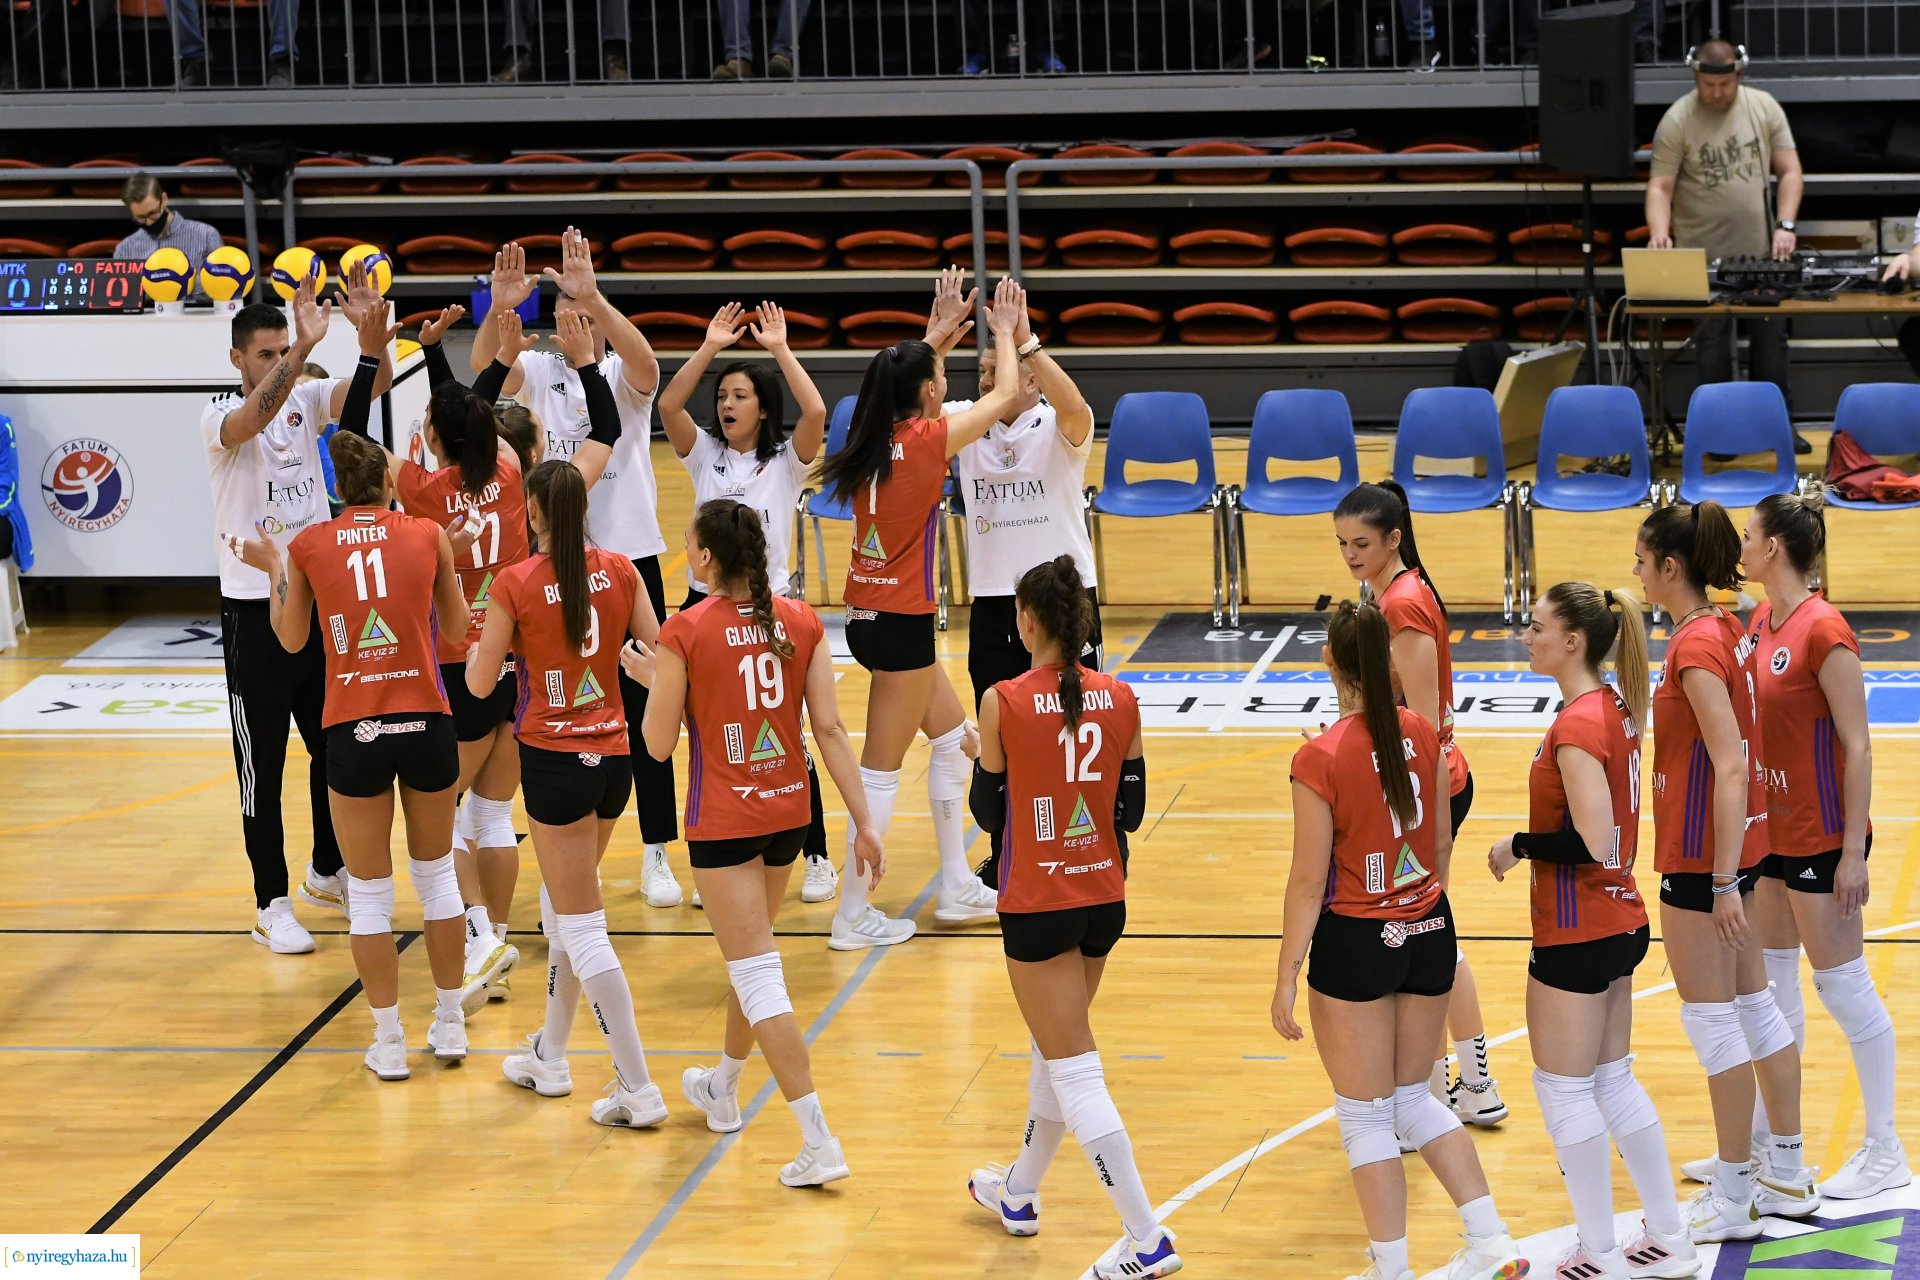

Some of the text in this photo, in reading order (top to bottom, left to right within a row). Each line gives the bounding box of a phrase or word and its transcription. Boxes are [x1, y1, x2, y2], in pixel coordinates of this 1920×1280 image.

[96, 263, 143, 274] FATUM
[62, 441, 108, 455] FATUM
[972, 478, 1045, 499] FATUM
[974, 494, 1047, 506] PROPERTY
[992, 515, 1050, 529] NYÍREGYHÁZA
[336, 525, 388, 546] PINTÉR
[346, 548, 388, 601] 11
[333, 616, 347, 652] STRABAG
[358, 646, 398, 659] KE-VIZ 21
[360, 669, 419, 683] BESTRONG
[738, 652, 784, 711] 19
[552, 672, 561, 705] STRABAG
[381, 720, 426, 735] REVESZ
[730, 725, 740, 762] STRABAG
[1058, 722, 1102, 783] 12
[750, 762, 776, 772] KE-VIZ
[758, 781, 804, 799] BESTRONG
[1041, 799, 1050, 838] STRABAG
[1063, 835, 1092, 848] KE-VIZ
[1065, 858, 1113, 875] BESTRONG
[1406, 917, 1445, 935] REVESZ
